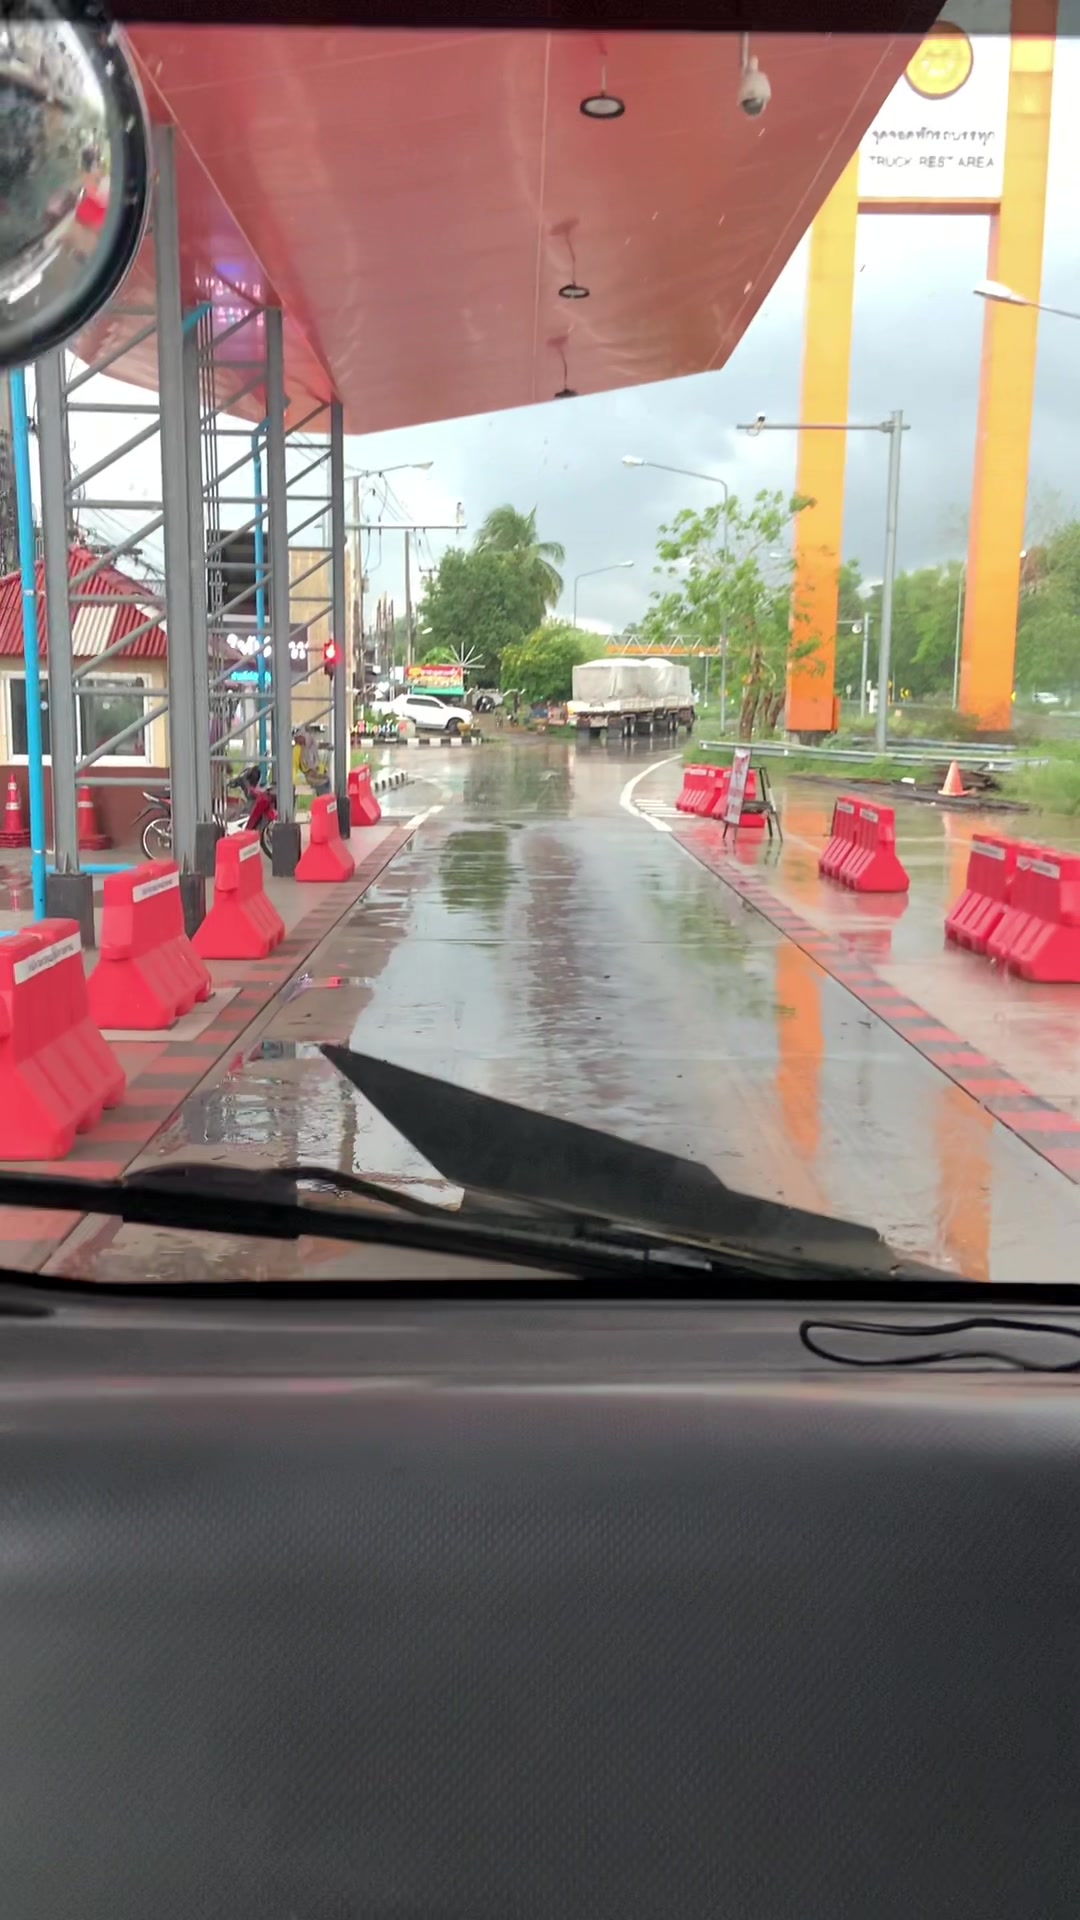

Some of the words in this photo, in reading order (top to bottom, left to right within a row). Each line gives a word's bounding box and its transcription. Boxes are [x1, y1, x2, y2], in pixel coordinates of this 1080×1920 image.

[869, 155, 912, 168] TRUCK
[919, 155, 953, 168] REST
[958, 156, 994, 169] AREA
